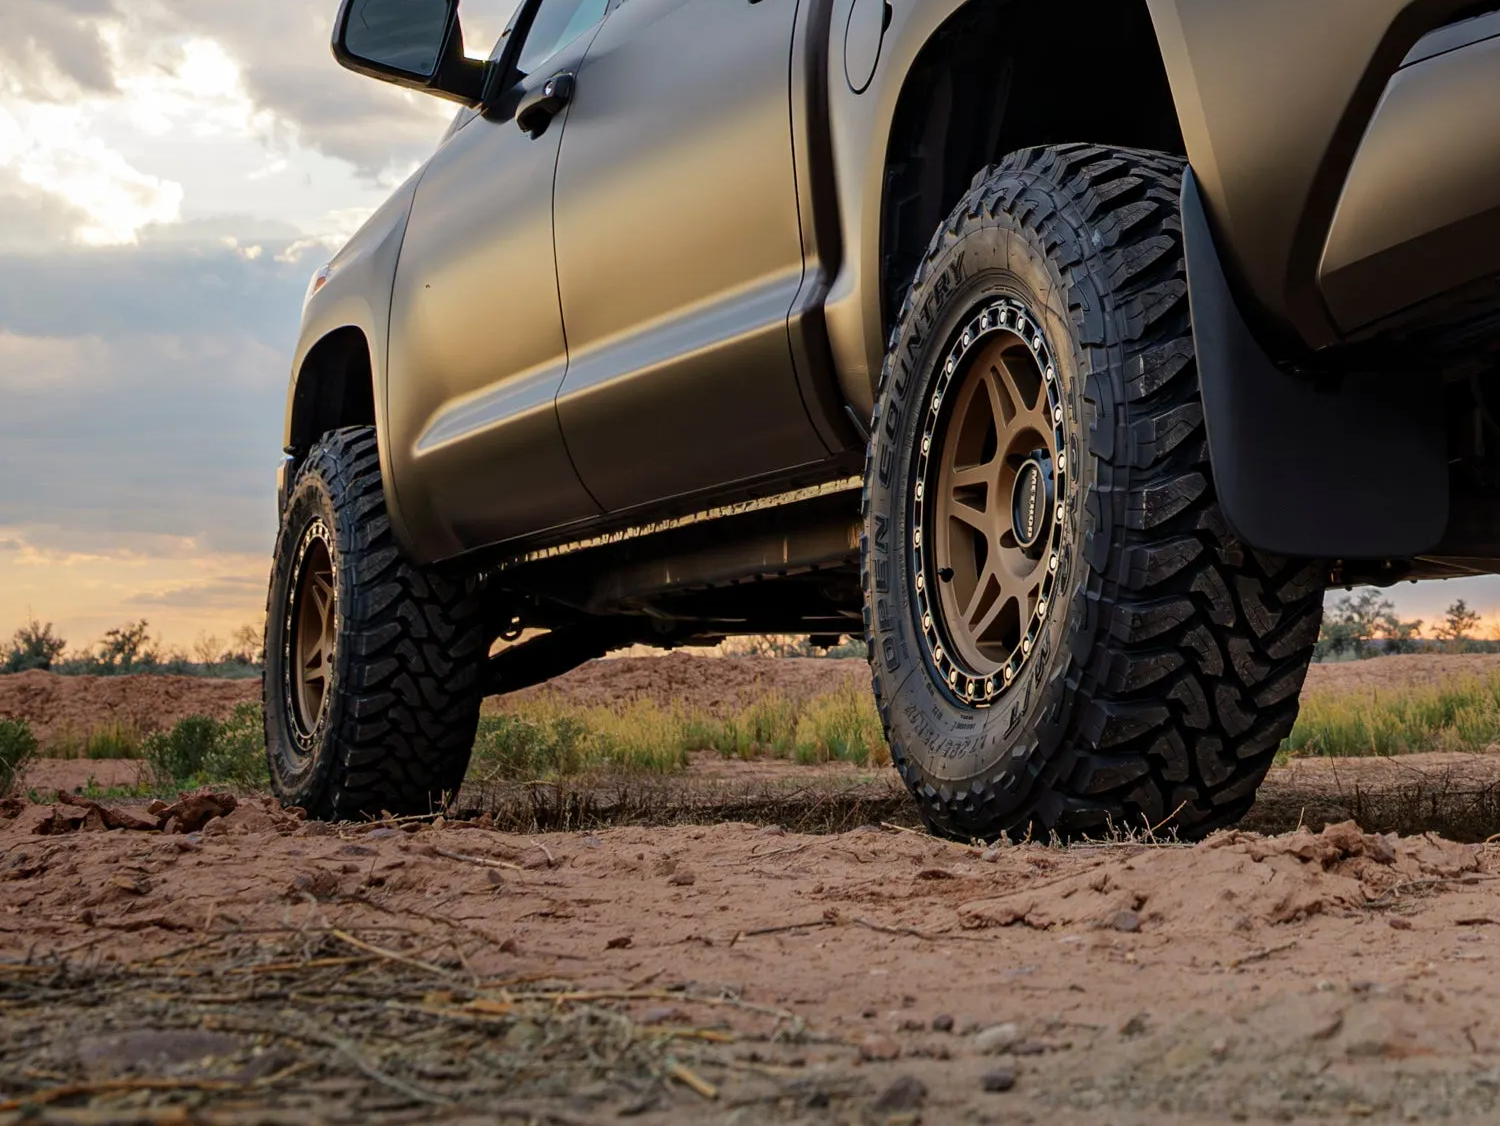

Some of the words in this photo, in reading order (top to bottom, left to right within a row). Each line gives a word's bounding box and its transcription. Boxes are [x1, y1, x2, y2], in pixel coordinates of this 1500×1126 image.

[879, 250, 967, 489] COUNTRY
[1026, 468, 1038, 538] METHOD
[874, 514, 900, 673] OPEN
